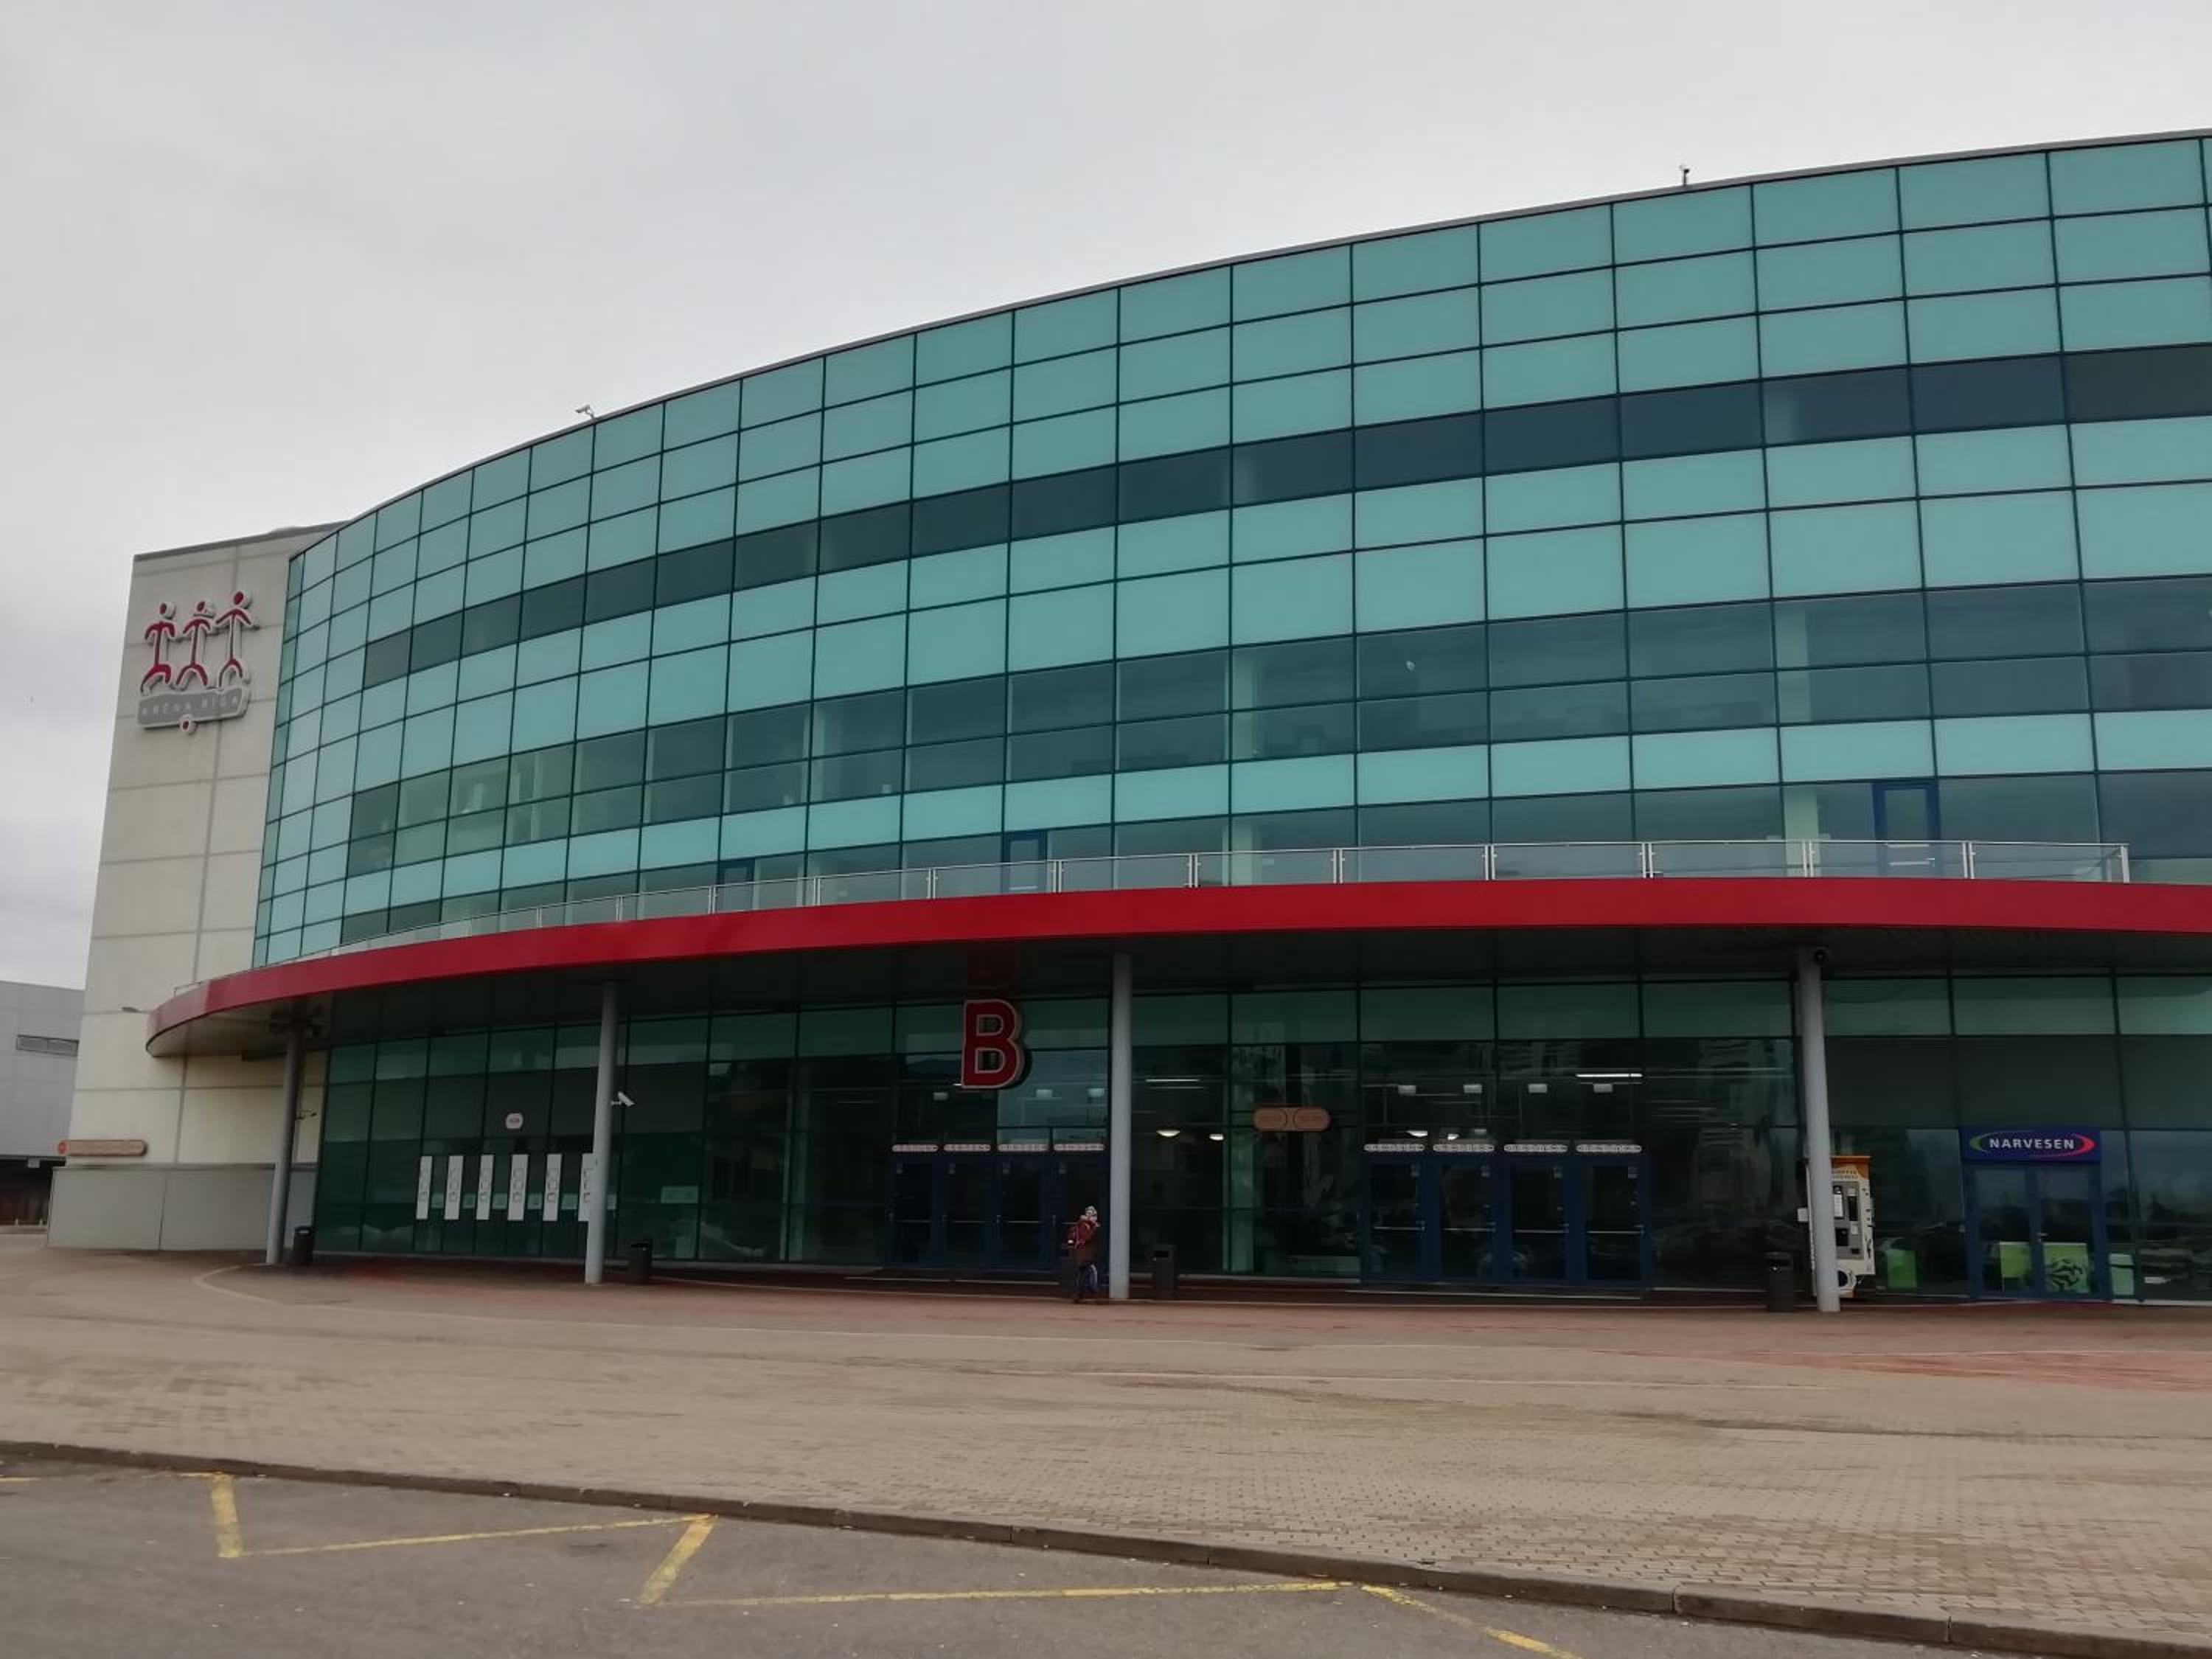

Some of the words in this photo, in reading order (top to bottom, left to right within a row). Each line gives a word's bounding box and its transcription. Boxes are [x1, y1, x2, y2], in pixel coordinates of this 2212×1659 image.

[141, 702, 192, 714] ARENA
[201, 695, 238, 709] RIGA
[961, 998, 1025, 1089] B
[1989, 1137, 2076, 1150] NARVESEN
